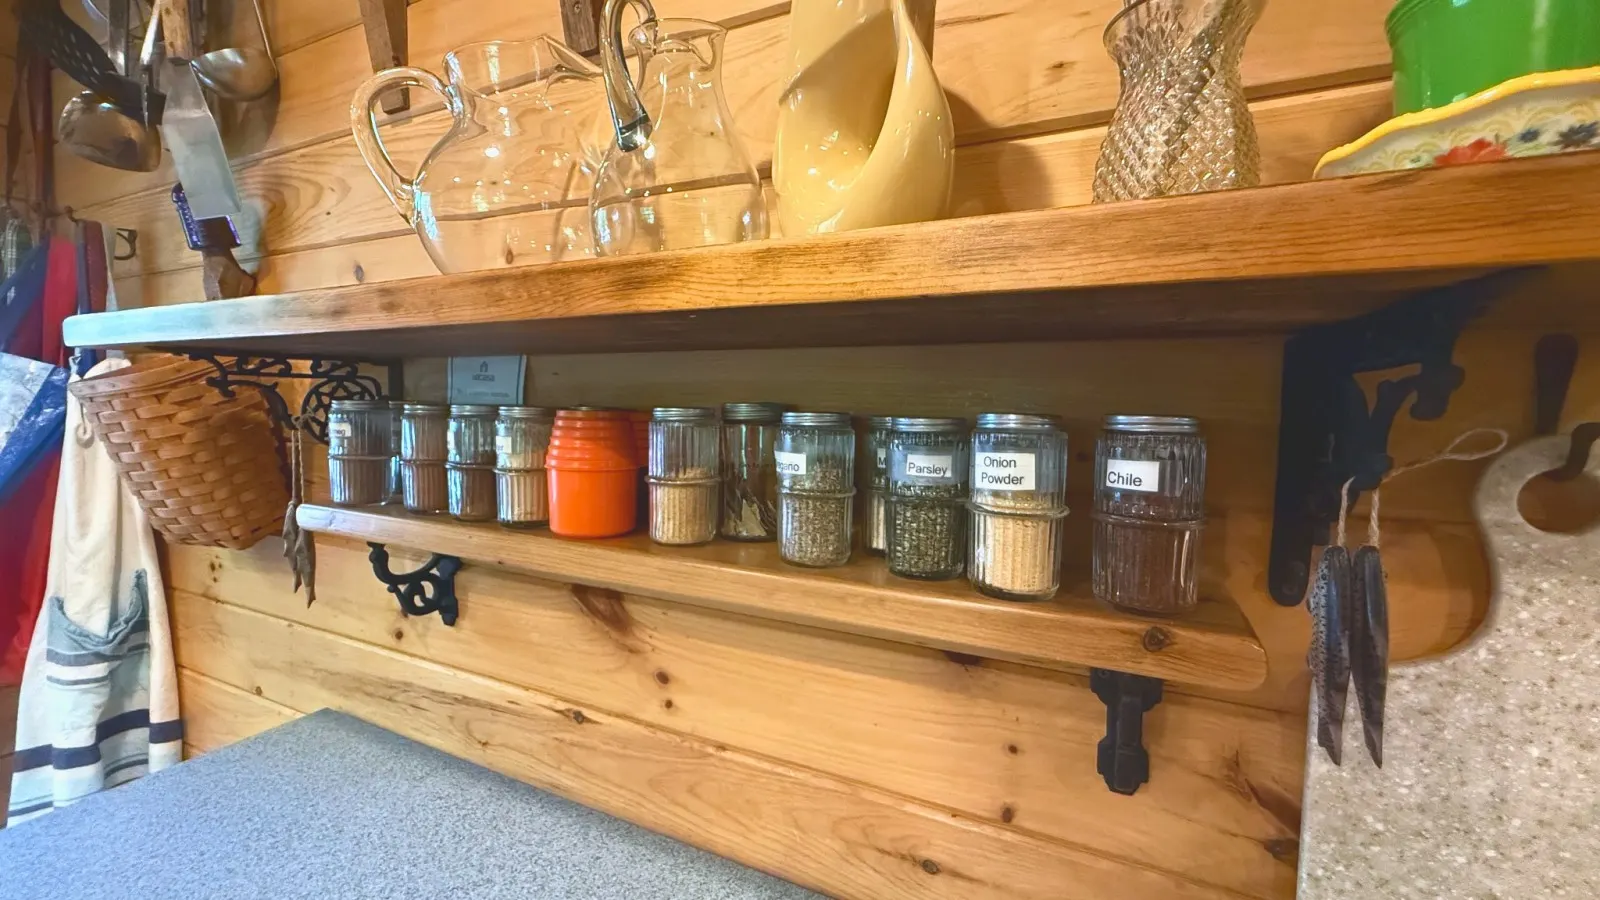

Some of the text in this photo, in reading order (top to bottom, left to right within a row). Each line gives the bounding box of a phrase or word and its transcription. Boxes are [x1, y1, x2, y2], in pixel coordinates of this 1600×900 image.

[983, 456, 1017, 468] Onion
[908, 462, 947, 479] Parsley
[981, 472, 1024, 485] Powder
[1107, 471, 1142, 487] Chile
